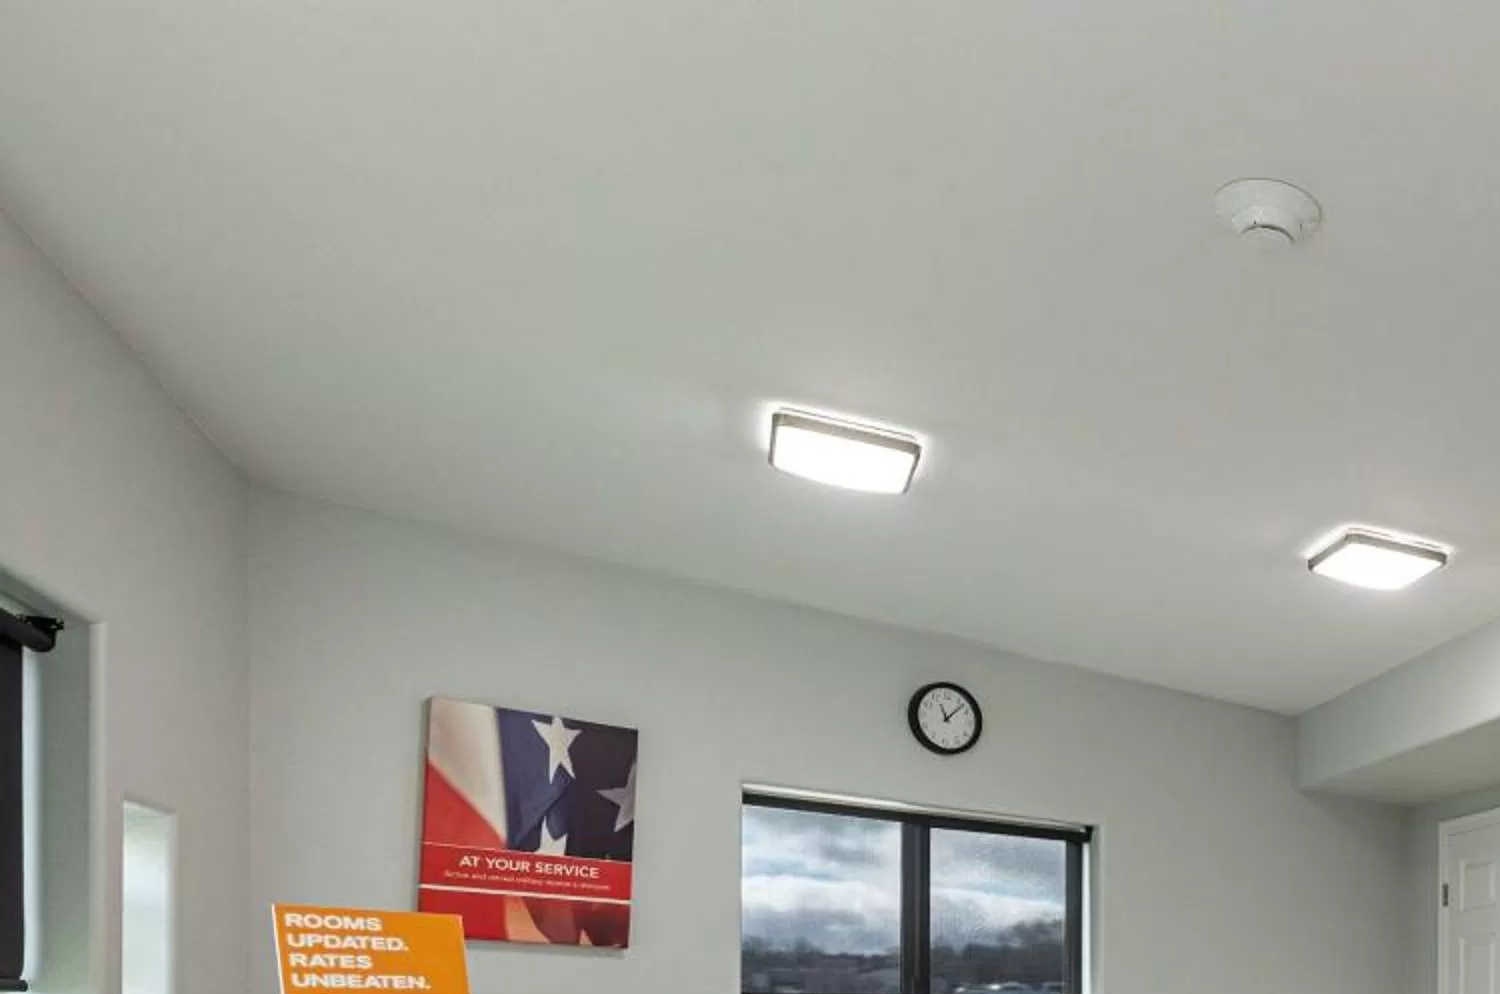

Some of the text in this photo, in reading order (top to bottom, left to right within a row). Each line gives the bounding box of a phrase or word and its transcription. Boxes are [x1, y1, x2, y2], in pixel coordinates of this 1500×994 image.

[458, 855, 601, 880] AT YOUR SERVICE
[284, 912, 383, 931] ROOMS
[286, 933, 410, 952] UPDATED.
[288, 953, 374, 969] RATES
[291, 973, 432, 989] UNBEATEN.
